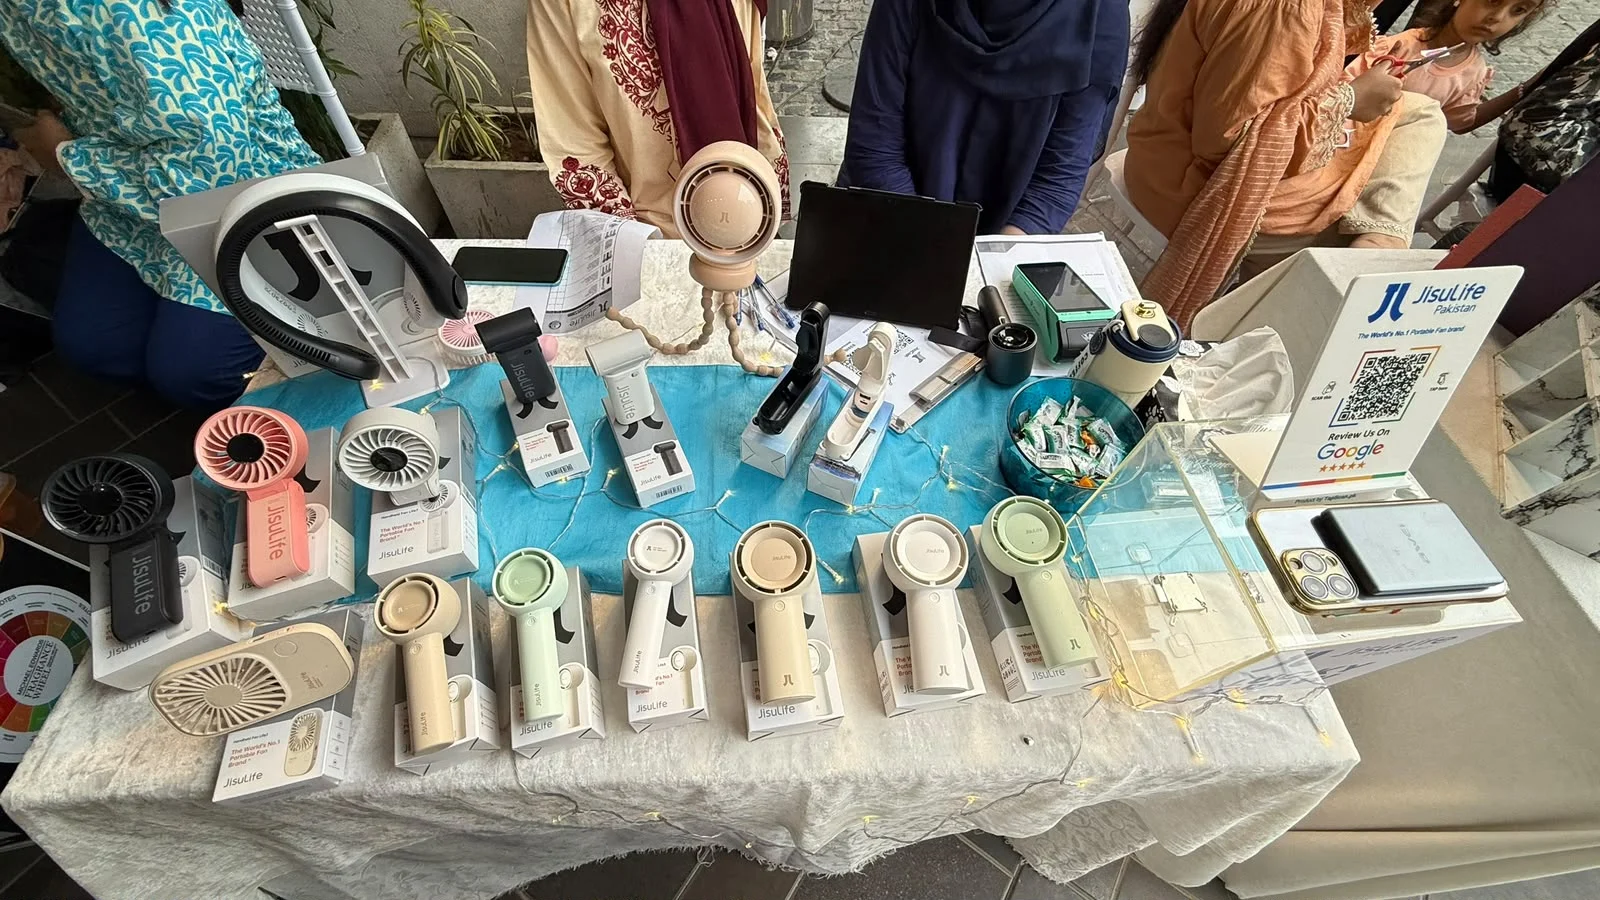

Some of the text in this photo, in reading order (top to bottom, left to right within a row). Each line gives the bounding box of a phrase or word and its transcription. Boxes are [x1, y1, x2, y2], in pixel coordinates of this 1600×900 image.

[1412, 283, 1486, 304] JisuLife
[1433, 303, 1476, 315] Pakistan
[1358, 332, 1369, 340] The
[1370, 330, 1394, 339] World's
[1410, 327, 1434, 336] Portable
[1447, 325, 1466, 333] brand
[510, 362, 535, 399] JisuLife
[616, 385, 635, 419] JisuLife
[1328, 428, 1391, 441] Review Us On
[1317, 439, 1385, 461] Google
[267, 505, 287, 561] JisuLife
[379, 530, 403, 538] Portable
[378, 545, 414, 560] JisuLife
[131, 555, 152, 616] JisuLife
[16, 638, 44, 696] MICHAEL EDWARDS
[23, 640, 54, 699] FRAGRANCE
[632, 650, 642, 674] JisuLife
[31, 667, 51, 700] WHEEL
[636, 700, 668, 713] JisuLife
[758, 704, 796, 719] JisuLife
[519, 720, 553, 737] JisuLife
[229, 748, 268, 762] Portable Fan
[243, 743, 268, 753] World's
[223, 771, 263, 788] JisuLife
